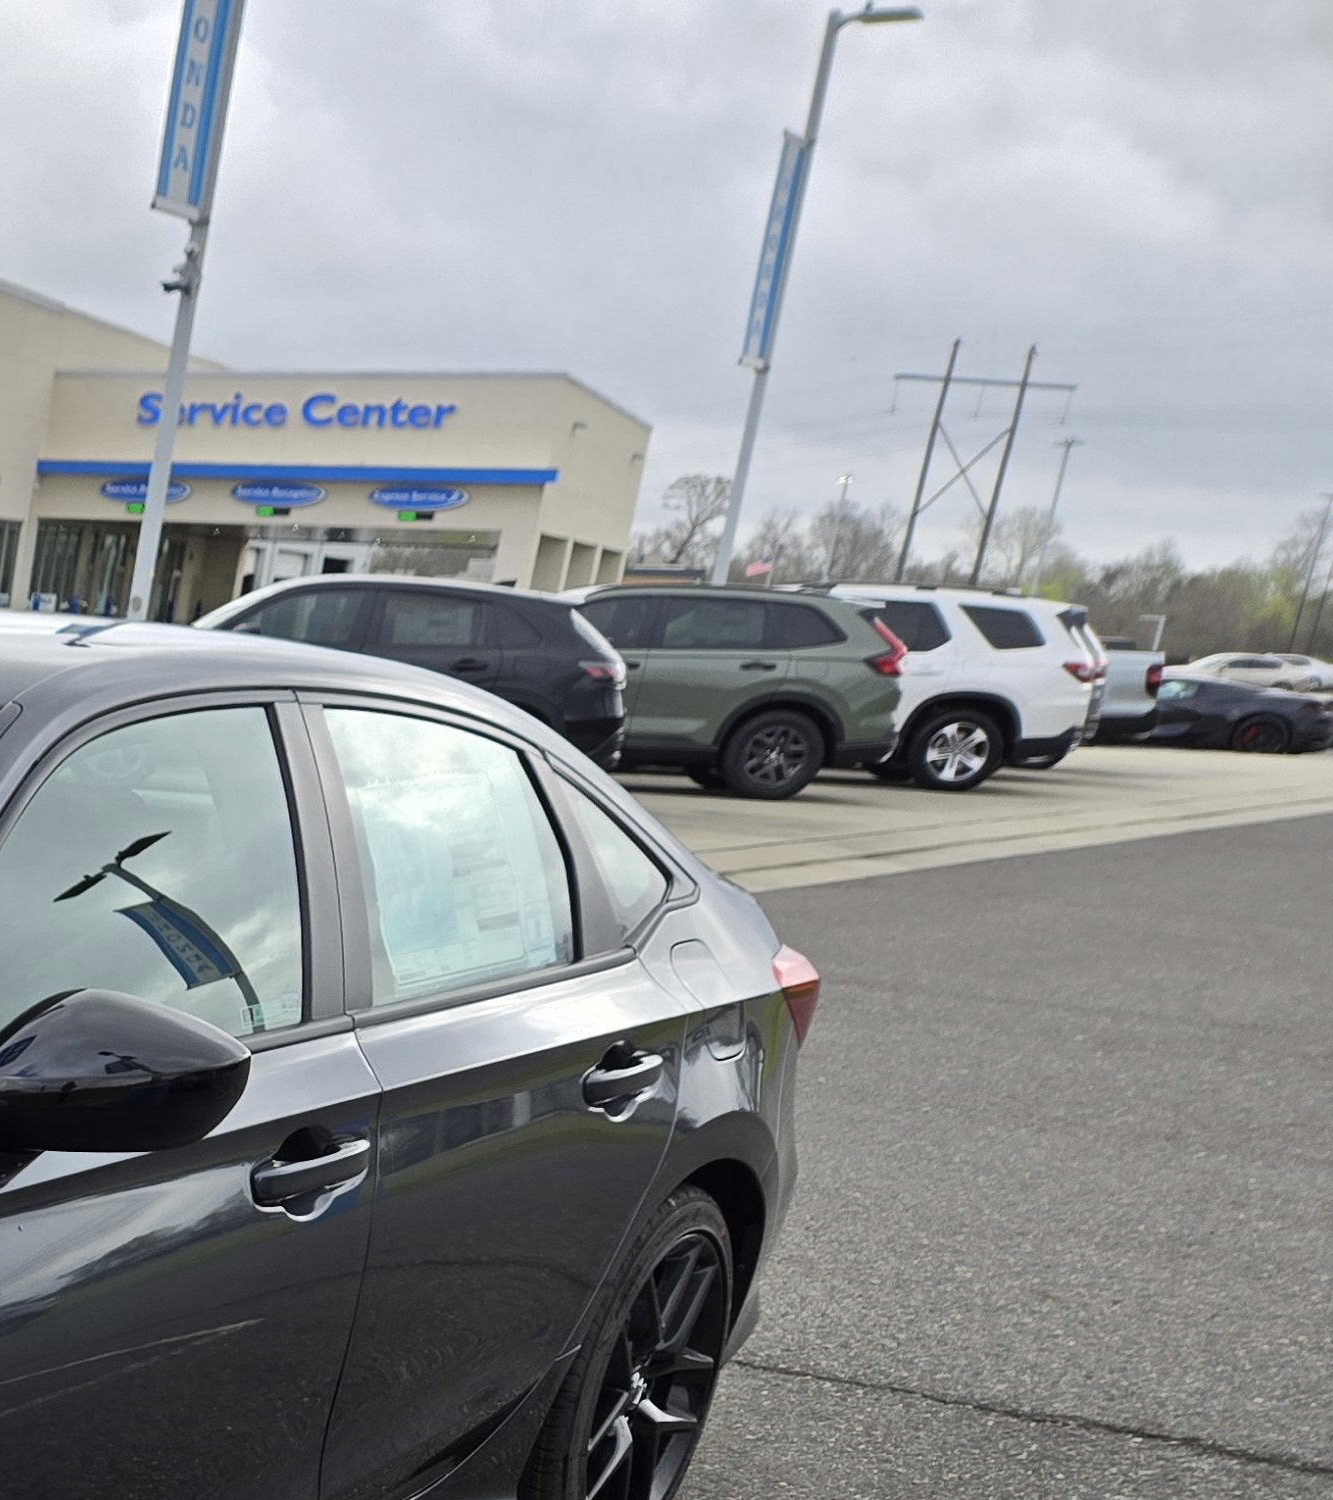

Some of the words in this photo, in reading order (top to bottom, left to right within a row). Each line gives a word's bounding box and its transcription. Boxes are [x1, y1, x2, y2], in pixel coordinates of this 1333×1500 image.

[174, 15, 210, 172] ONDA
[137, 391, 288, 428] Srvice
[301, 392, 456, 429] Center
